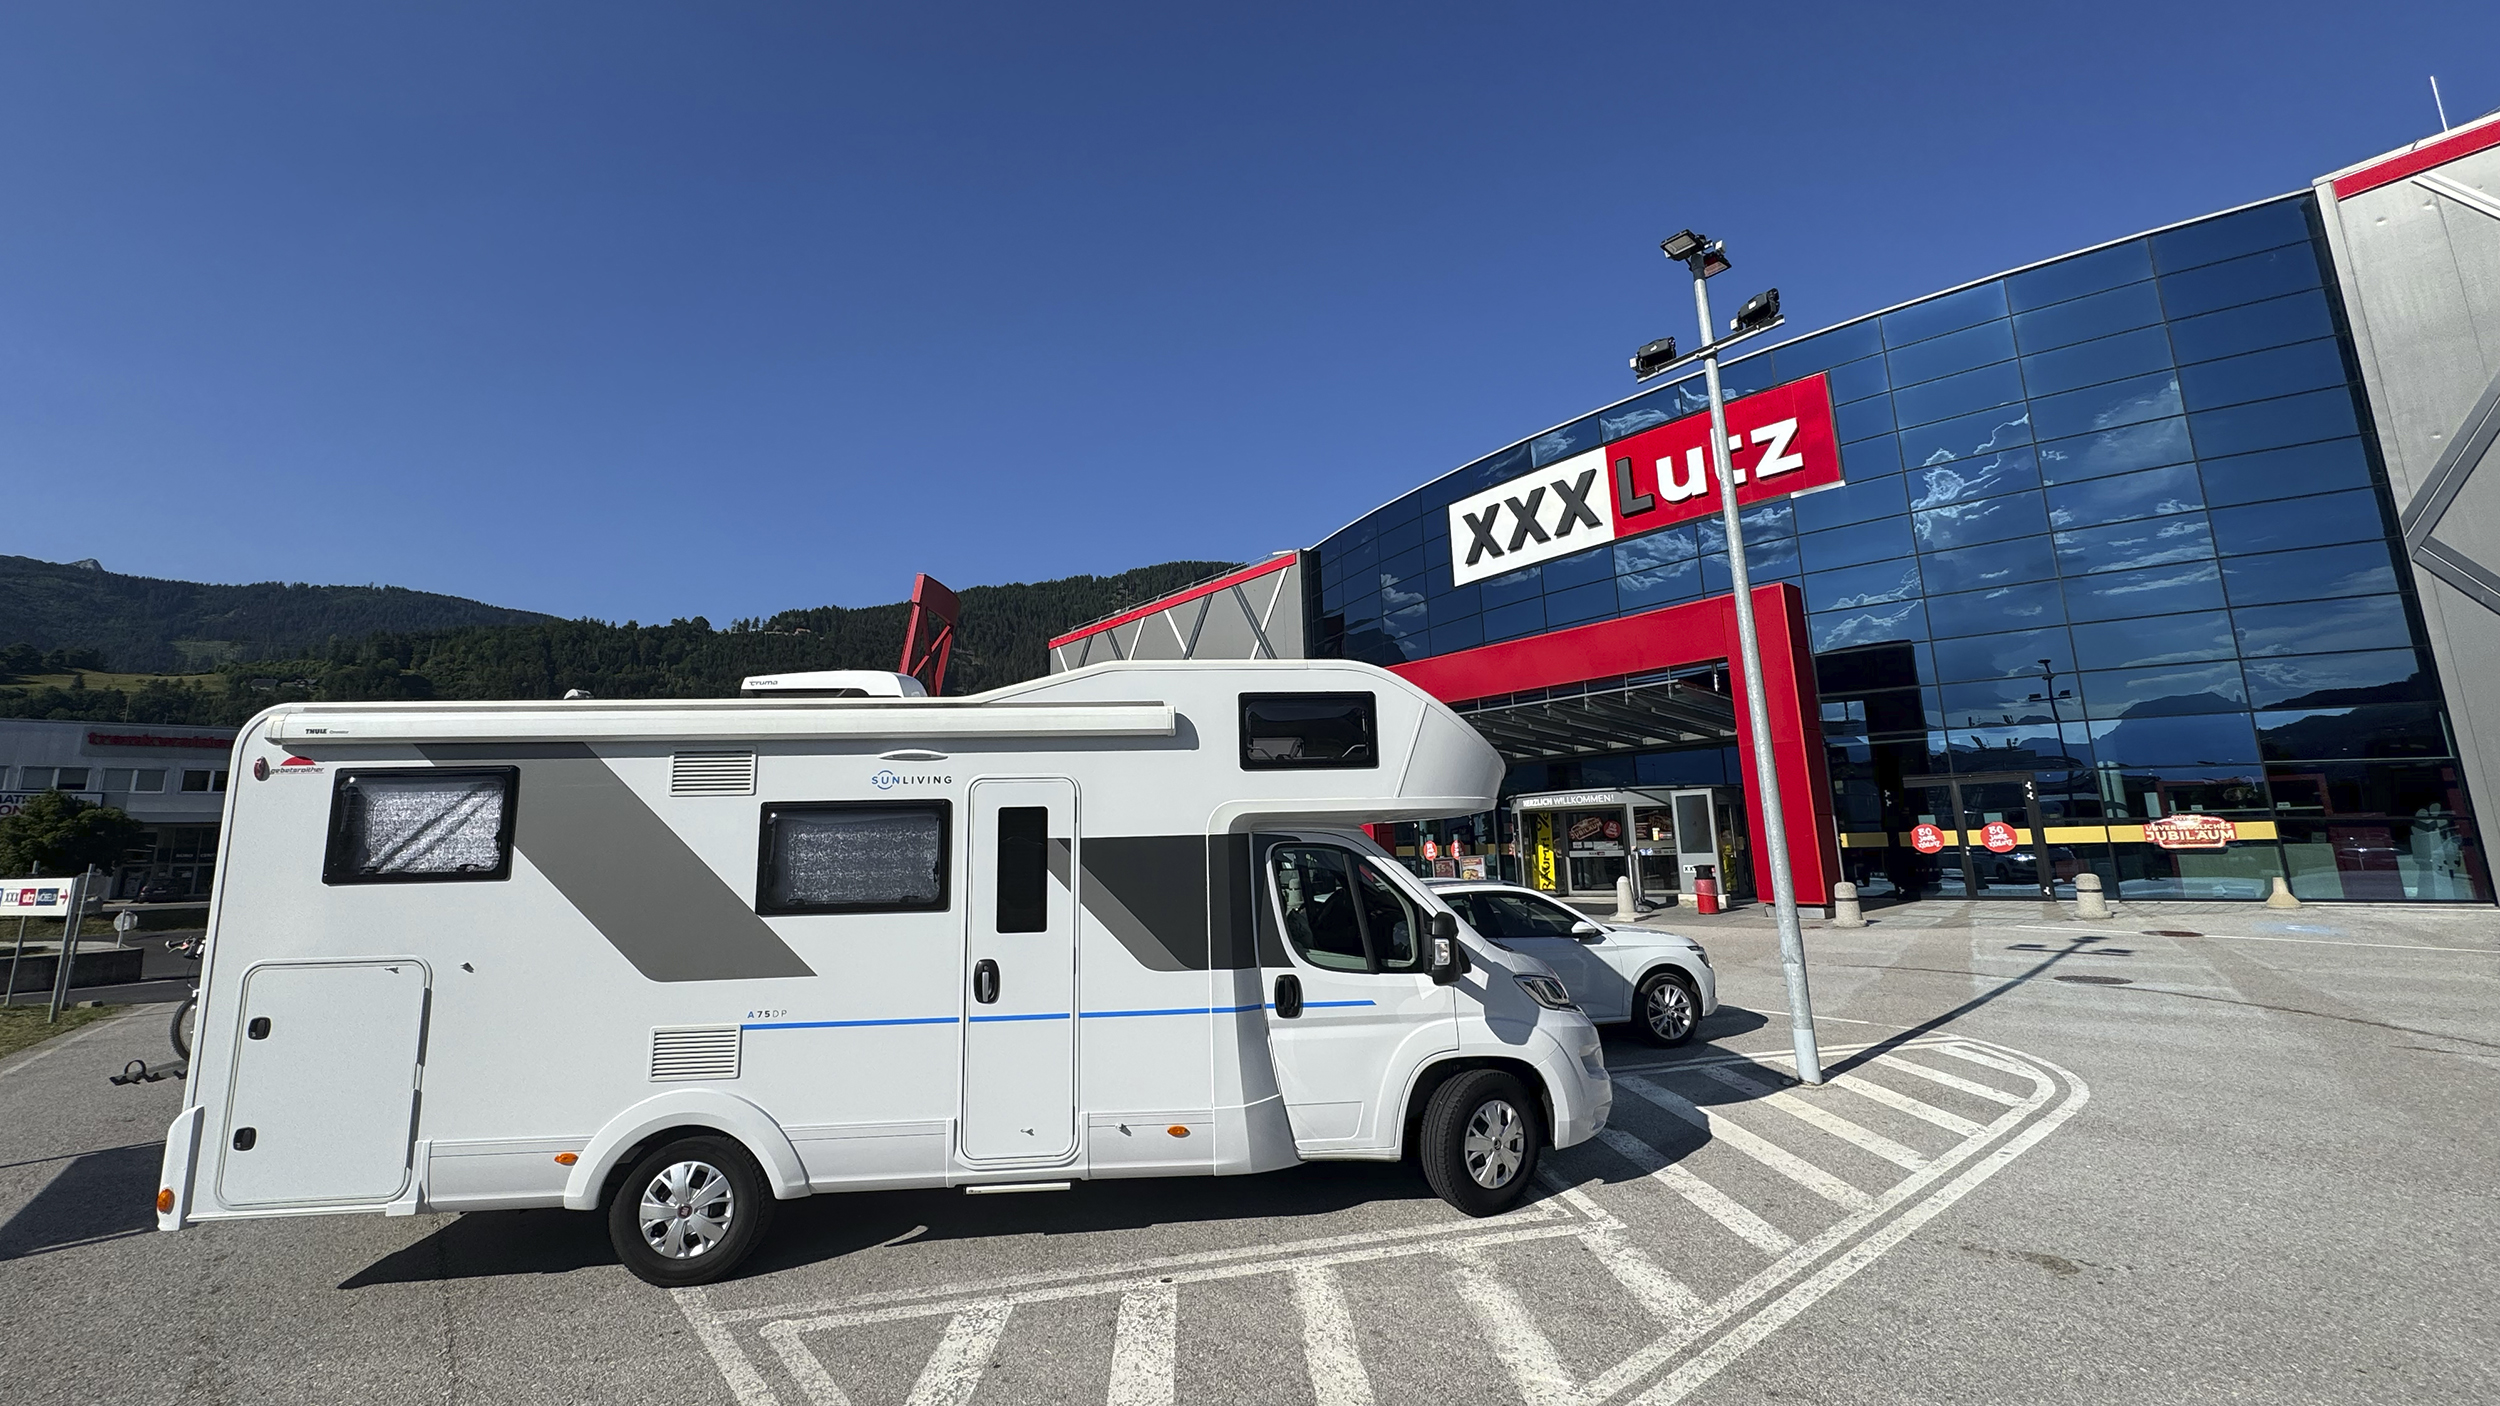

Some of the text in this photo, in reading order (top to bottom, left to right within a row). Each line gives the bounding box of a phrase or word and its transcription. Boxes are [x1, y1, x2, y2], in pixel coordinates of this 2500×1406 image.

[1462, 417, 1803, 566] XXXLutz
[871, 774, 953, 786] SUNLIVING
[1523, 793, 1615, 808] HERZLICH WILLKOMMEN!
[2145, 829, 2235, 841] JUBILÄUM
